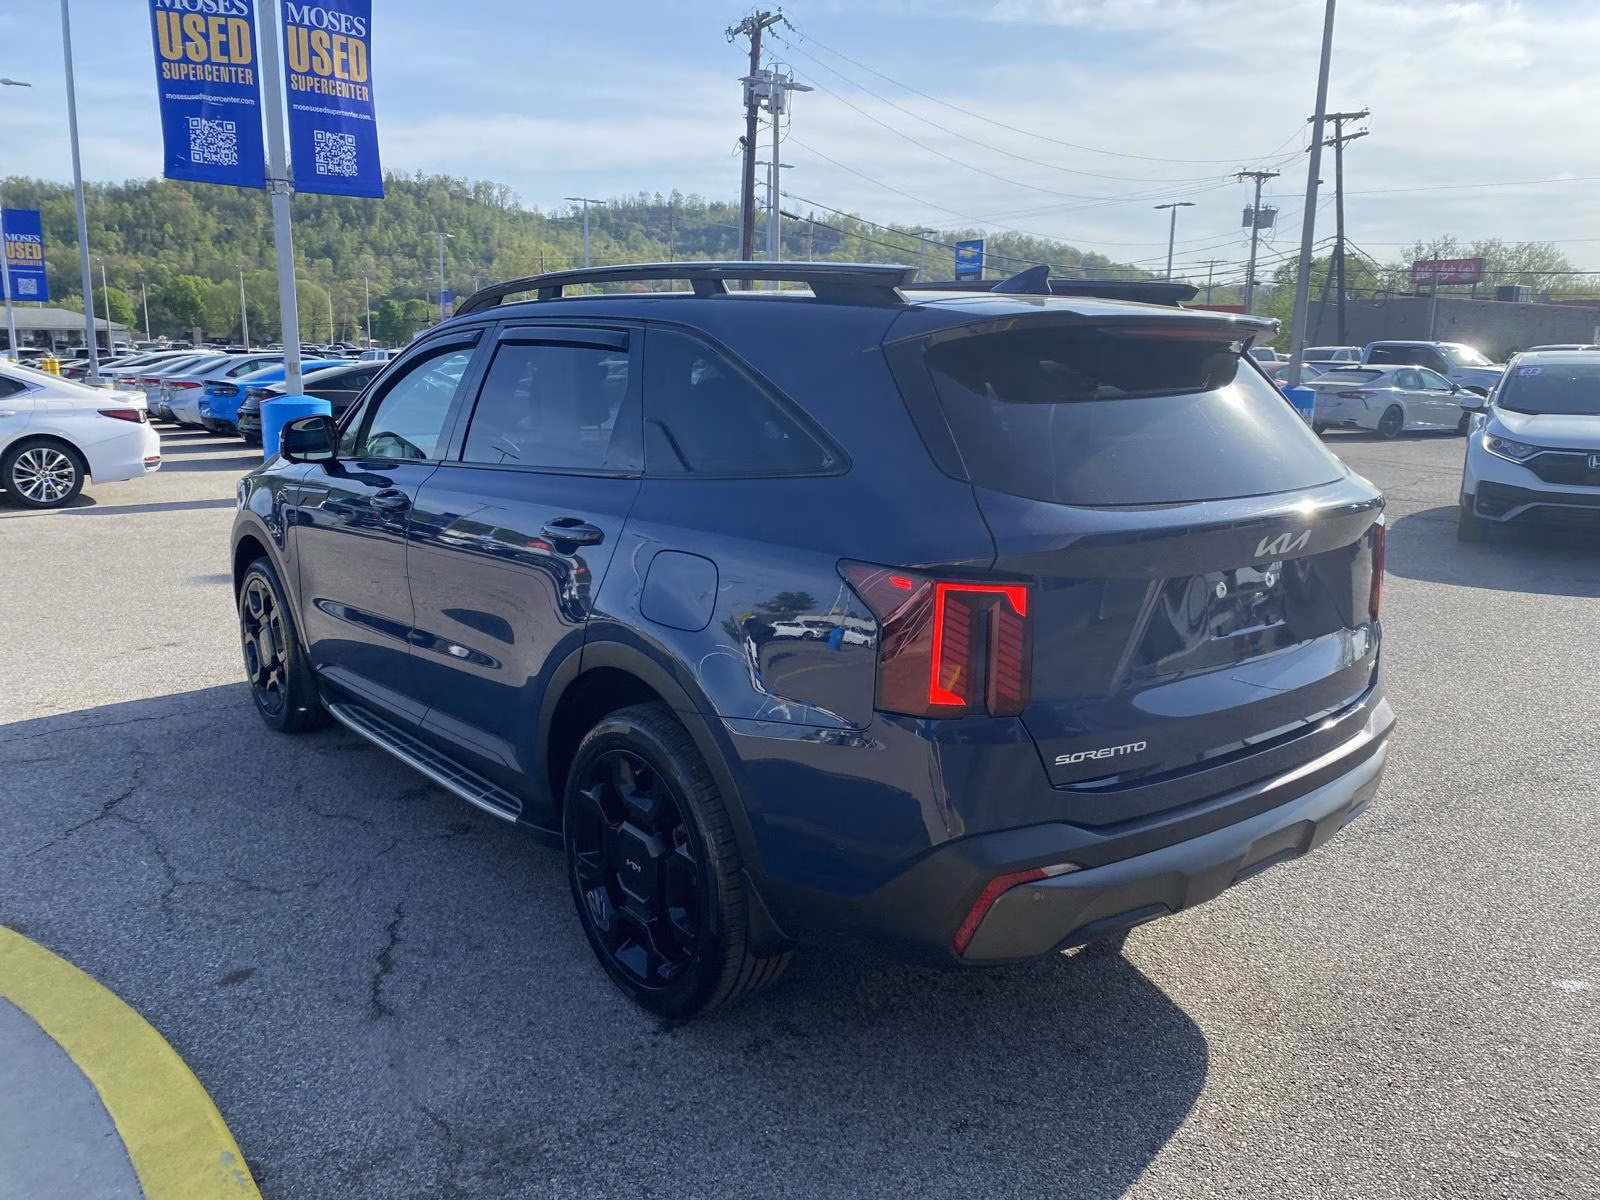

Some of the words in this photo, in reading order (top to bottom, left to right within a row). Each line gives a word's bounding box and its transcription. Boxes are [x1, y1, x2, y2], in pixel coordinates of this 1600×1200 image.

[286, 1, 366, 38] MOSES
[156, 10, 252, 65] USED
[287, 25, 368, 83] USED
[162, 61, 254, 86] SUPERCENTER
[165, 92, 256, 106] mosesusedsupercenter.com
[290, 73, 369, 102] SUPERCENTER
[5, 233, 41, 243] MOSES
[6, 241, 42, 260] USED
[1254, 529, 1312, 557] KIA
[1054, 740, 1147, 766] SORENTO
